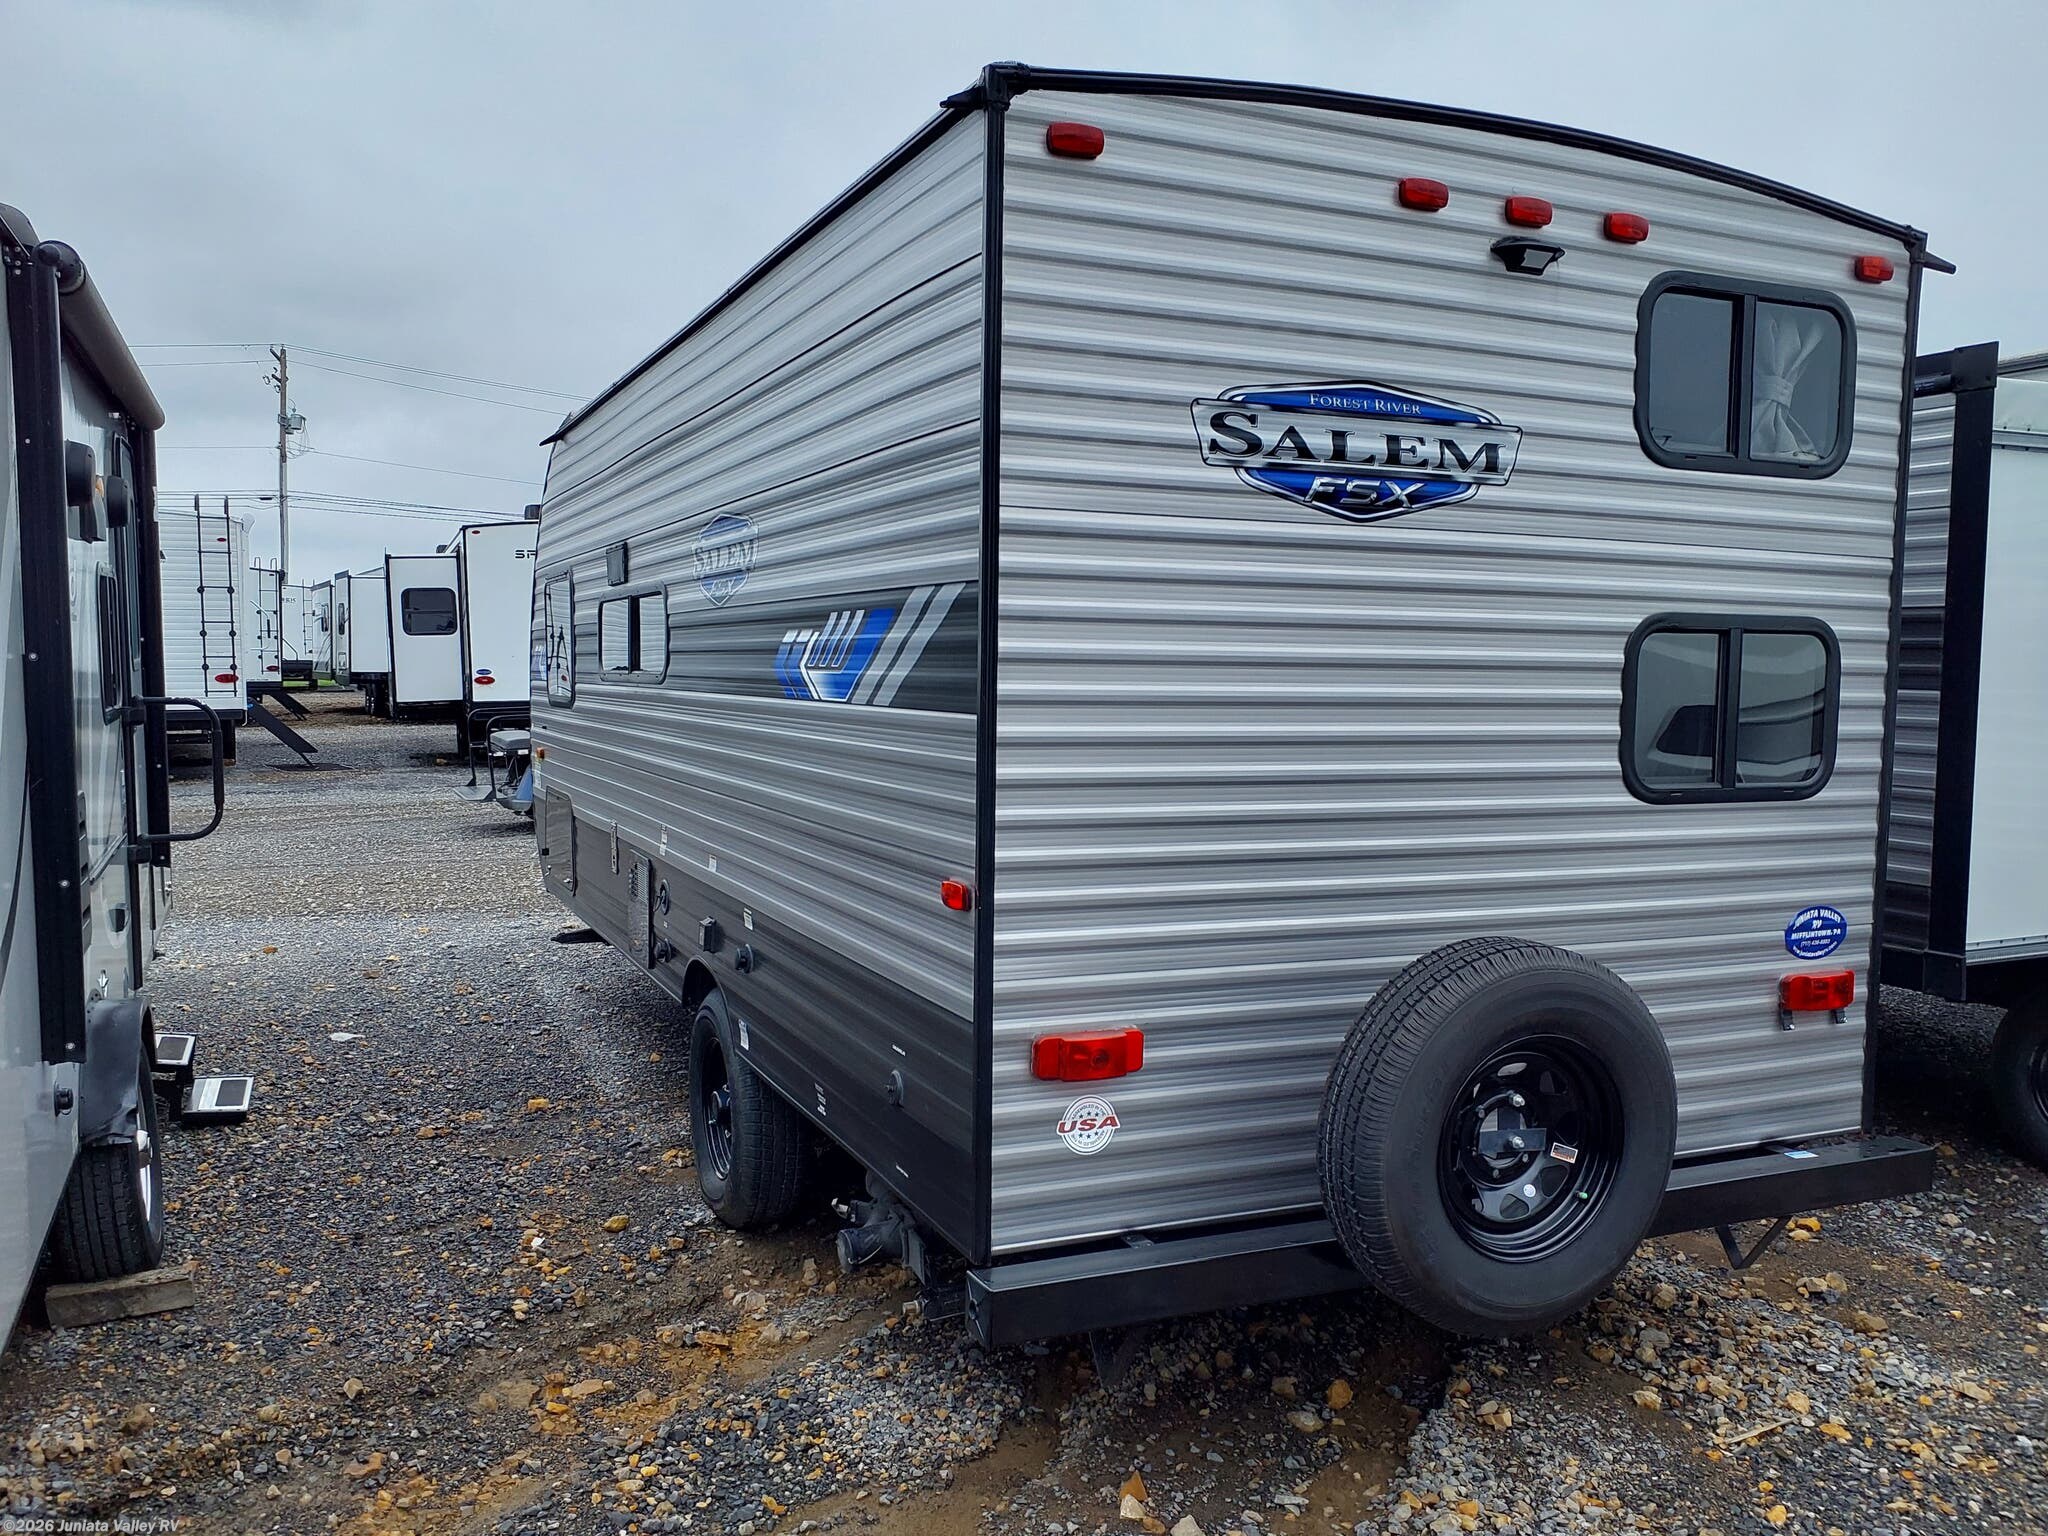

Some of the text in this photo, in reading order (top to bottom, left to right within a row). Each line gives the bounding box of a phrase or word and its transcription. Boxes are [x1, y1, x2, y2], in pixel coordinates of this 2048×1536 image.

[1309, 392, 1422, 415] FOREST RIVER
[1207, 410, 1507, 477] SALEM
[1303, 475, 1426, 509] FSX
[693, 540, 759, 573] SALEM
[1811, 919, 1823, 930] RV
[1819, 909, 1842, 924] VALLEY
[1057, 1115, 1119, 1134] USA
